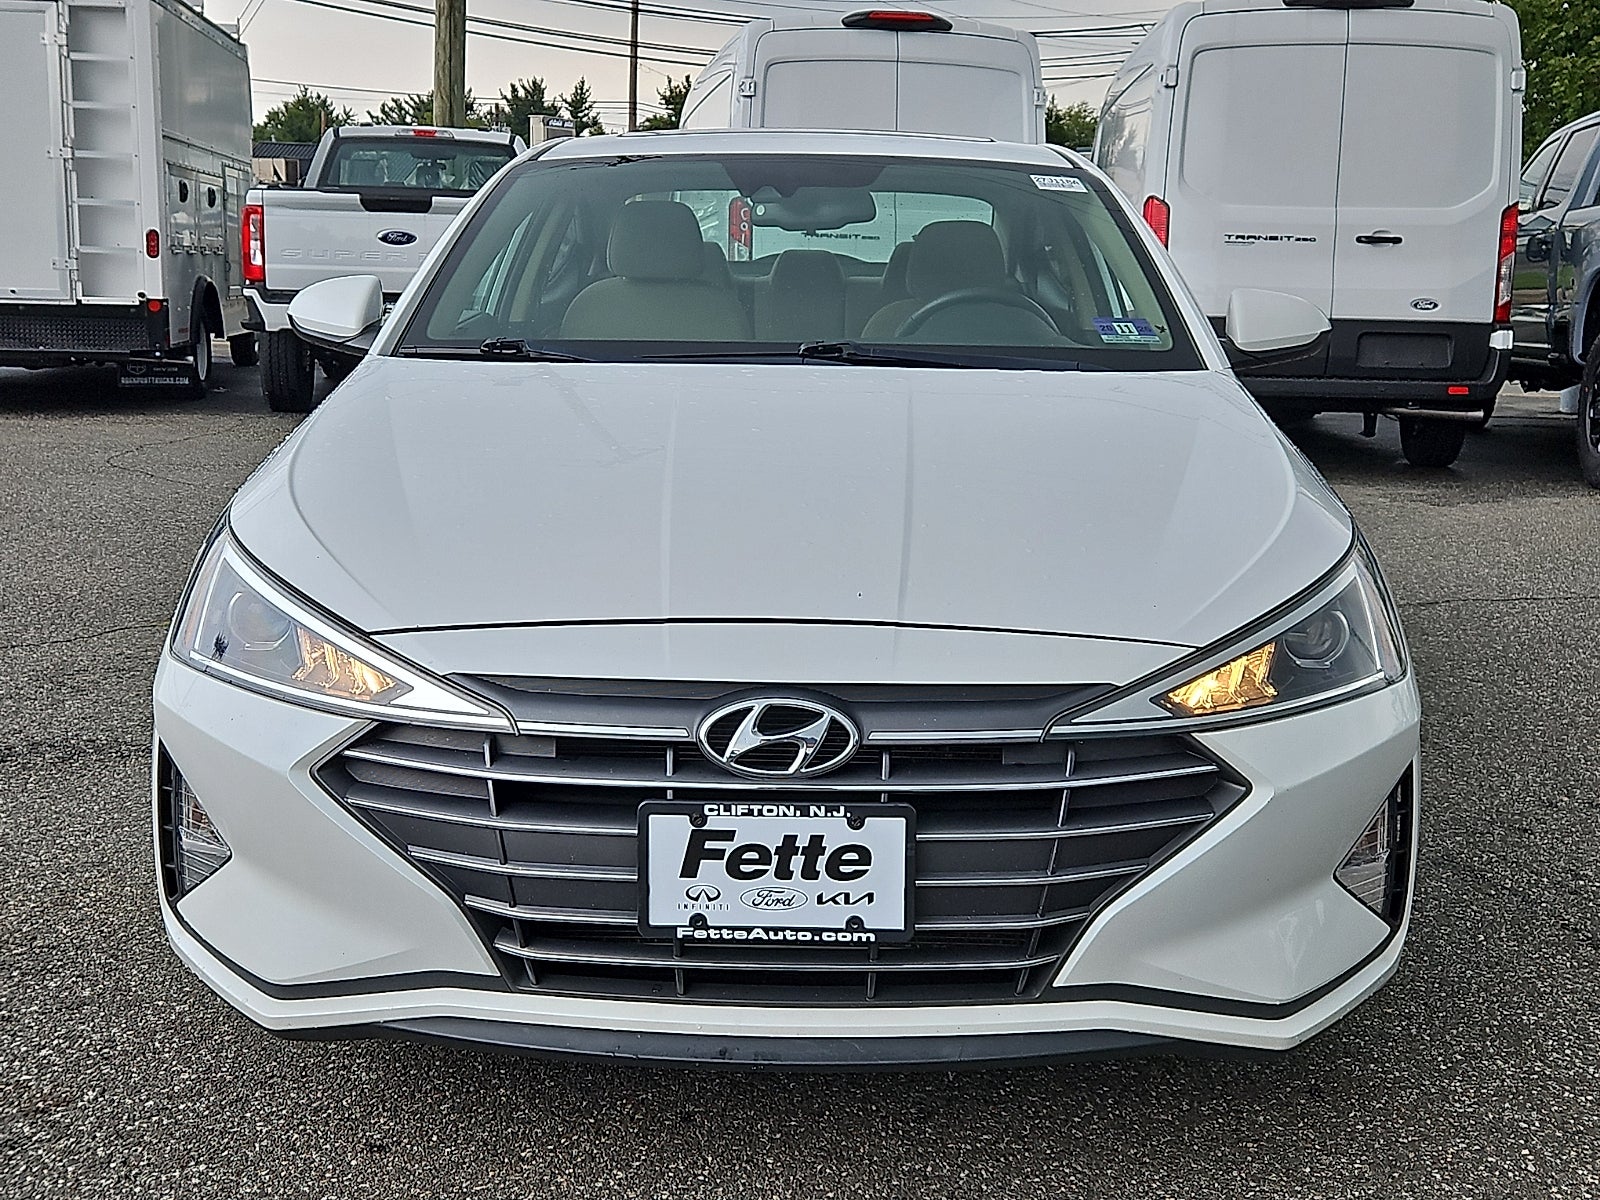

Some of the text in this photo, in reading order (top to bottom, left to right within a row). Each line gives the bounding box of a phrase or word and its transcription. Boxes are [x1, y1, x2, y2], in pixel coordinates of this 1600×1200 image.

[281, 248, 408, 262] SUPER
[1116, 324, 1135, 334] 11
[703, 804, 851, 818] CLIFTON, N.J.
[678, 828, 873, 882] Fette
[751, 889, 797, 908] Ford
[677, 903, 730, 911] INFINITI
[676, 926, 876, 942] FetteAuto.com
